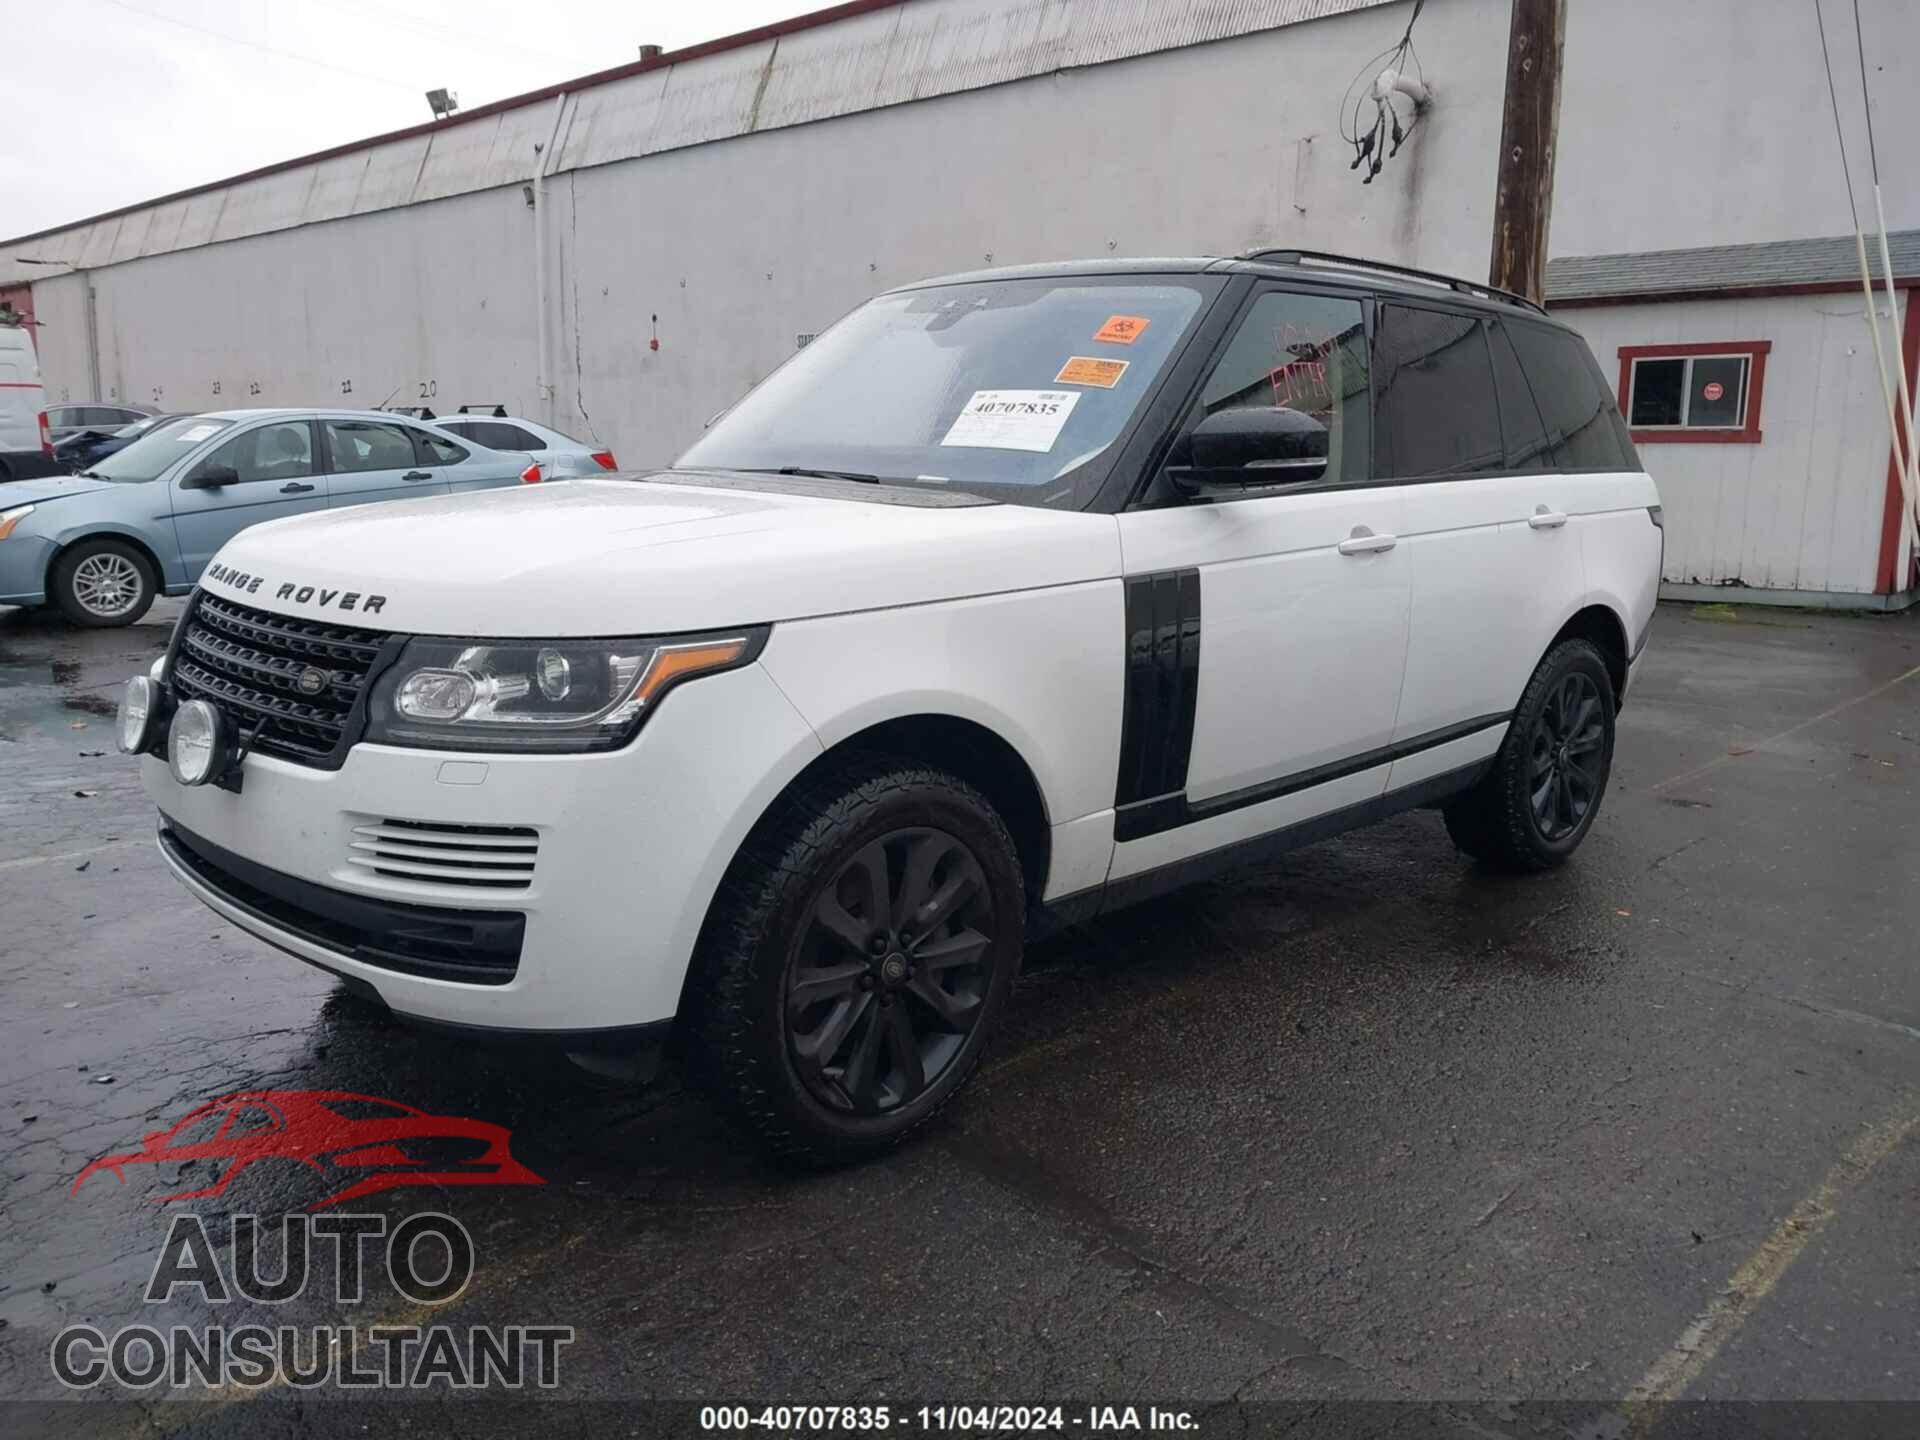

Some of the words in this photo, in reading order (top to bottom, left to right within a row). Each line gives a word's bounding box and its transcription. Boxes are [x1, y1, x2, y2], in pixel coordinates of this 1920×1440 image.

[419, 380, 437, 398] 20
[975, 402, 1060, 416] 40707835
[208, 563, 264, 594] RANGE
[276, 582, 387, 614] ROVER
